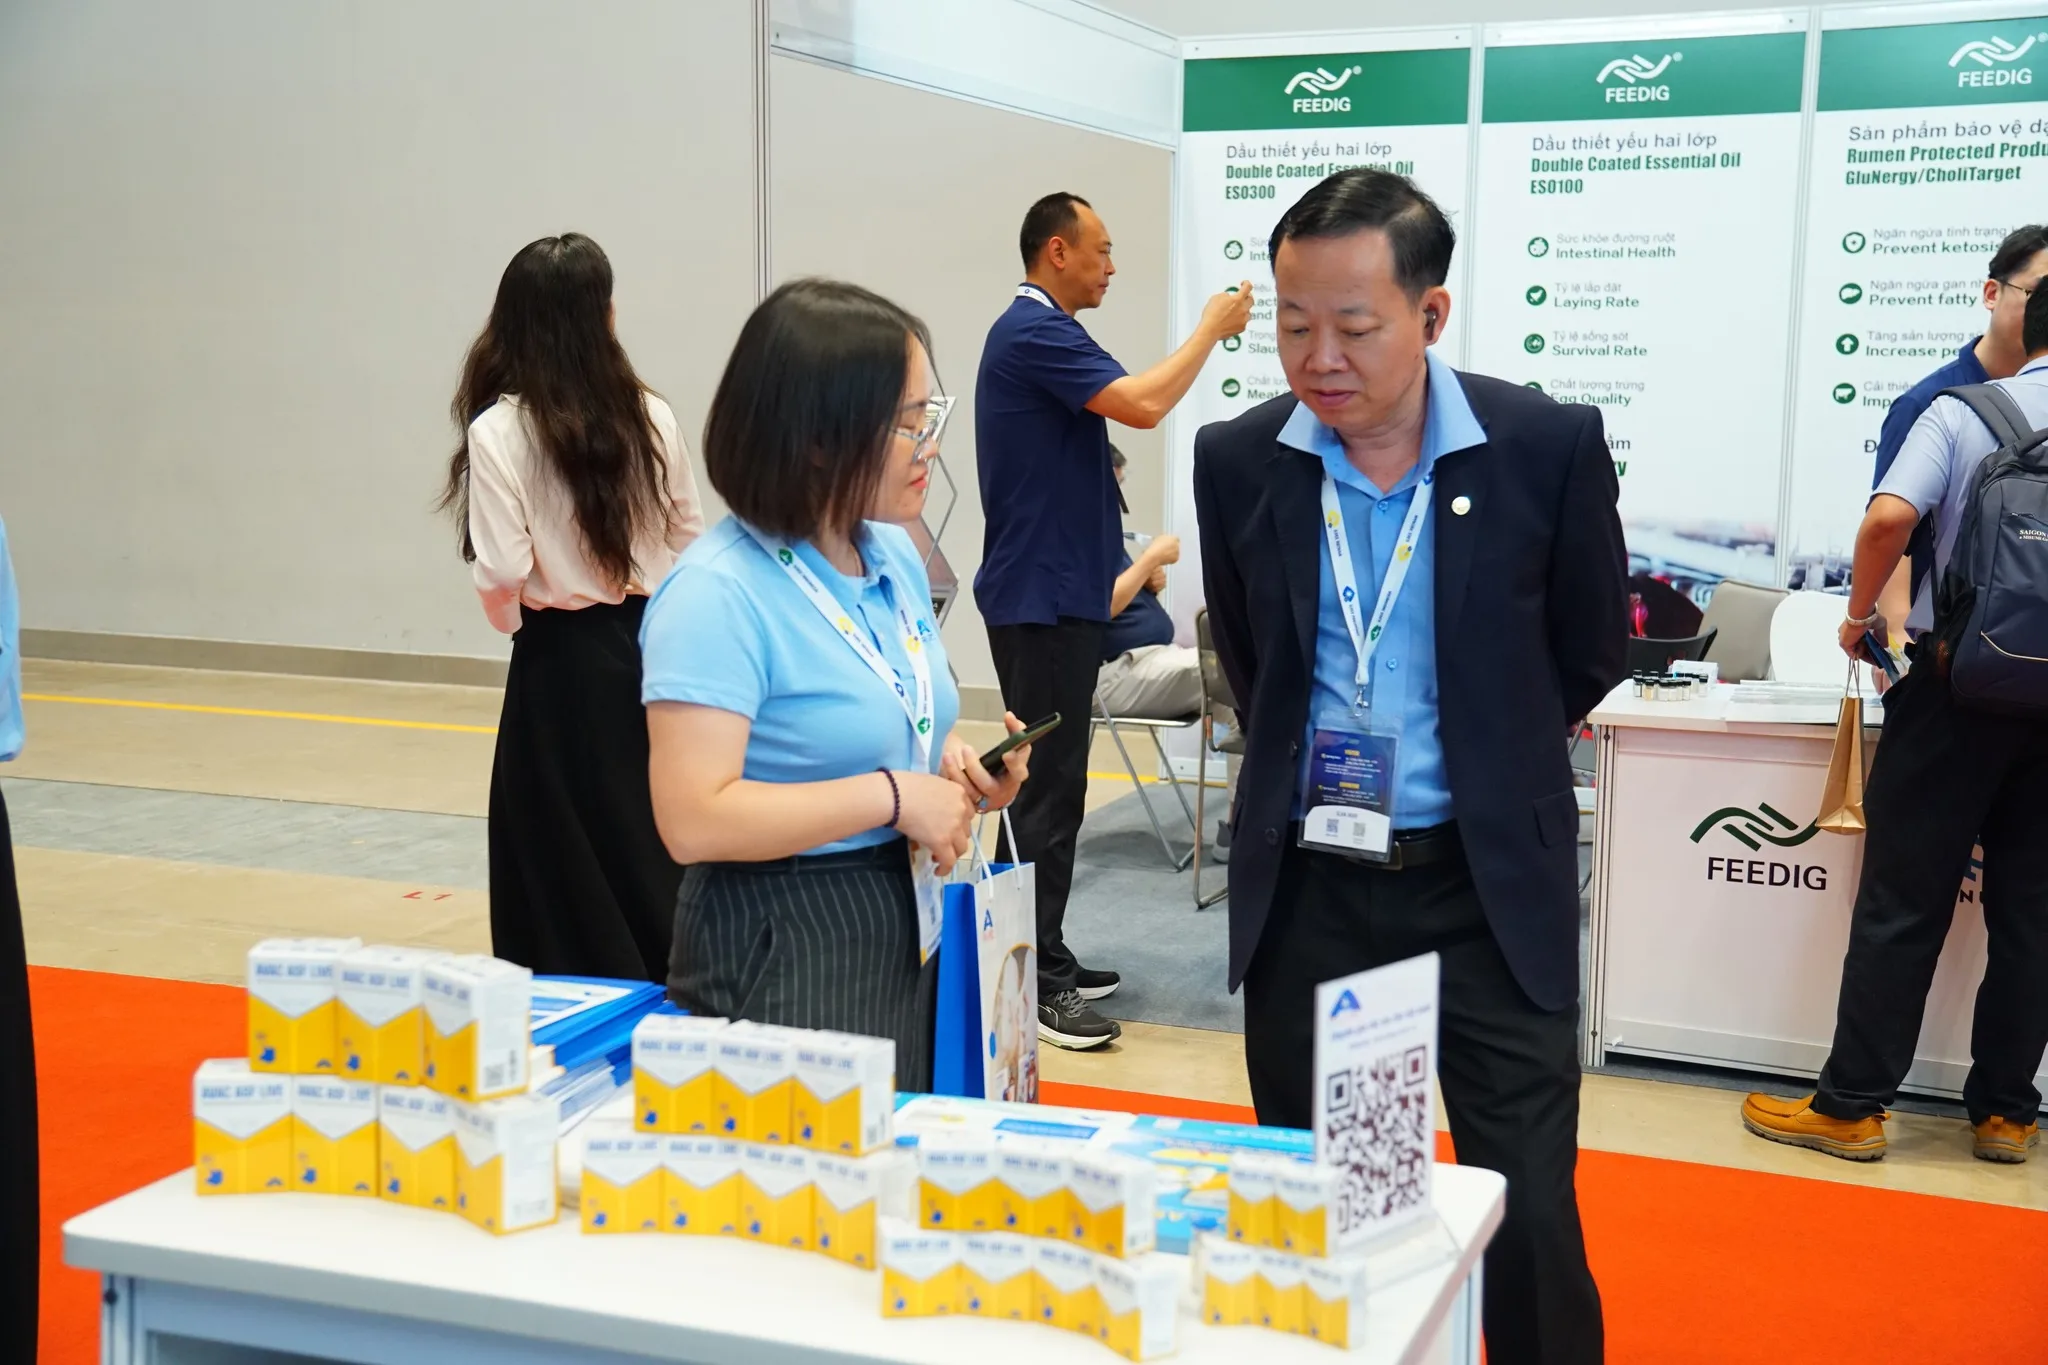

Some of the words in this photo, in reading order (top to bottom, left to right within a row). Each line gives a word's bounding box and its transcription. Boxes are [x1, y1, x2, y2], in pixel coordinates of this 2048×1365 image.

[1958, 68, 2032, 87] FEEDIG
[1605, 85, 1670, 103] FEEDIG
[1293, 97, 1351, 113] FEEDIG
[1849, 120, 1885, 141] Sản
[1892, 120, 1947, 143] phẩm
[1955, 120, 1992, 137] bảo
[1999, 119, 2022, 138] vệ
[1227, 140, 1256, 159] Dầu
[1262, 139, 1296, 158] thiết
[1302, 138, 1330, 160] yếu
[1336, 142, 1359, 156] hai
[1365, 141, 1392, 158] lớp
[1533, 132, 1565, 151] Dầu
[1572, 131, 1611, 150] thiết
[1616, 131, 1648, 152] yếu
[1654, 134, 1681, 148] hai
[1688, 132, 1717, 149] lớp
[1847, 147, 1905, 163] Rumen
[1910, 143, 1994, 161] Protected
[1226, 164, 1273, 179] Double
[1276, 163, 1324, 178] Coated
[1396, 160, 1413, 175] Oil
[1531, 157, 1583, 173] Double
[1588, 156, 1641, 171] Coated
[1646, 153, 1716, 169] Essential
[1721, 152, 1741, 167] Oil
[1845, 166, 2021, 185] GluNergy/CholiTarget
[1556, 247, 1624, 259] Intestinal
[1628, 246, 1676, 258] Health
[1873, 242, 1936, 254] Prevent
[1554, 296, 1601, 310] Laying
[1605, 296, 1640, 307] Rate
[1869, 294, 1932, 306] Prevent
[1938, 293, 1977, 307] fatty
[1552, 345, 1609, 356] Survival
[1614, 345, 1647, 356] Rate
[1866, 345, 1937, 357] Increase
[1581, 392, 1631, 407] Quality
[1707, 857, 1827, 891] FEEDIG
